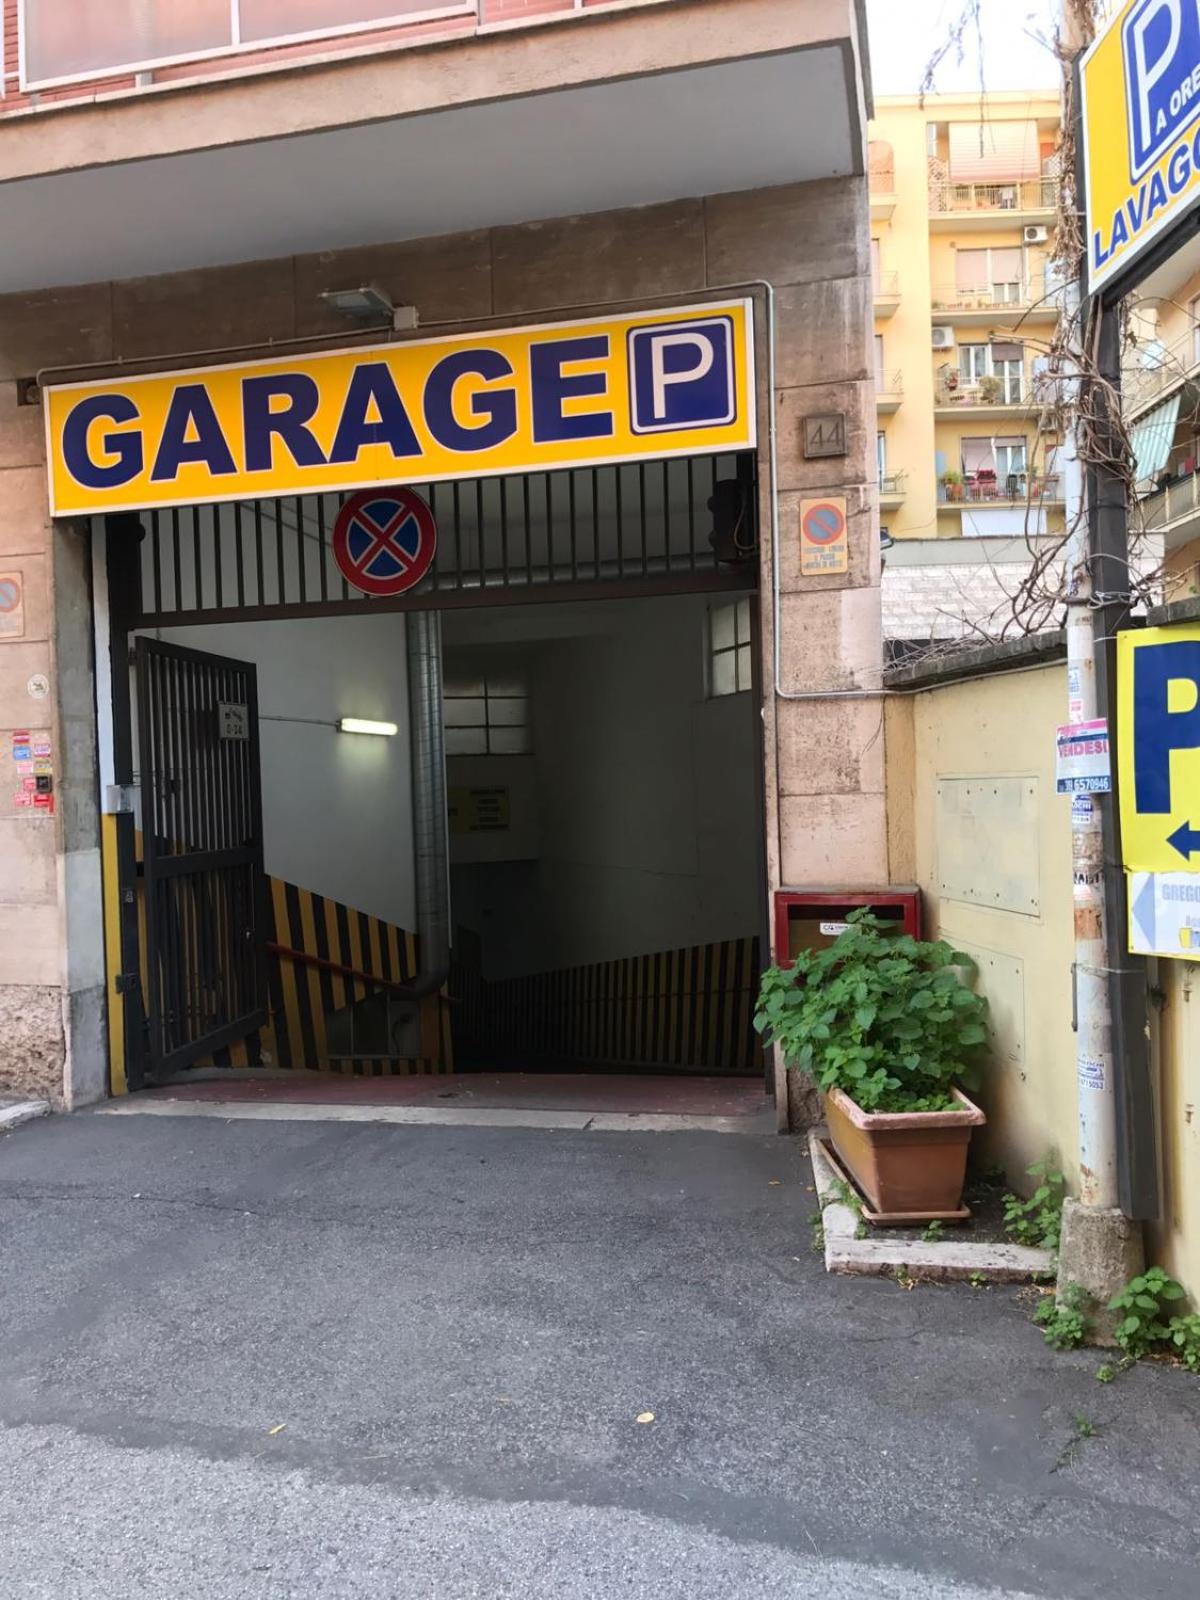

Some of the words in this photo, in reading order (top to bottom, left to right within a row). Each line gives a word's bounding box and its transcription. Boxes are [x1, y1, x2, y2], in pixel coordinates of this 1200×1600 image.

[1133, 0, 1181, 153] P
[1156, 108, 1167, 136] A
[62, 335, 614, 488] GARAGE
[651, 332, 714, 419] P
[810, 422, 843, 449] 44
[1134, 640, 1200, 814] P
